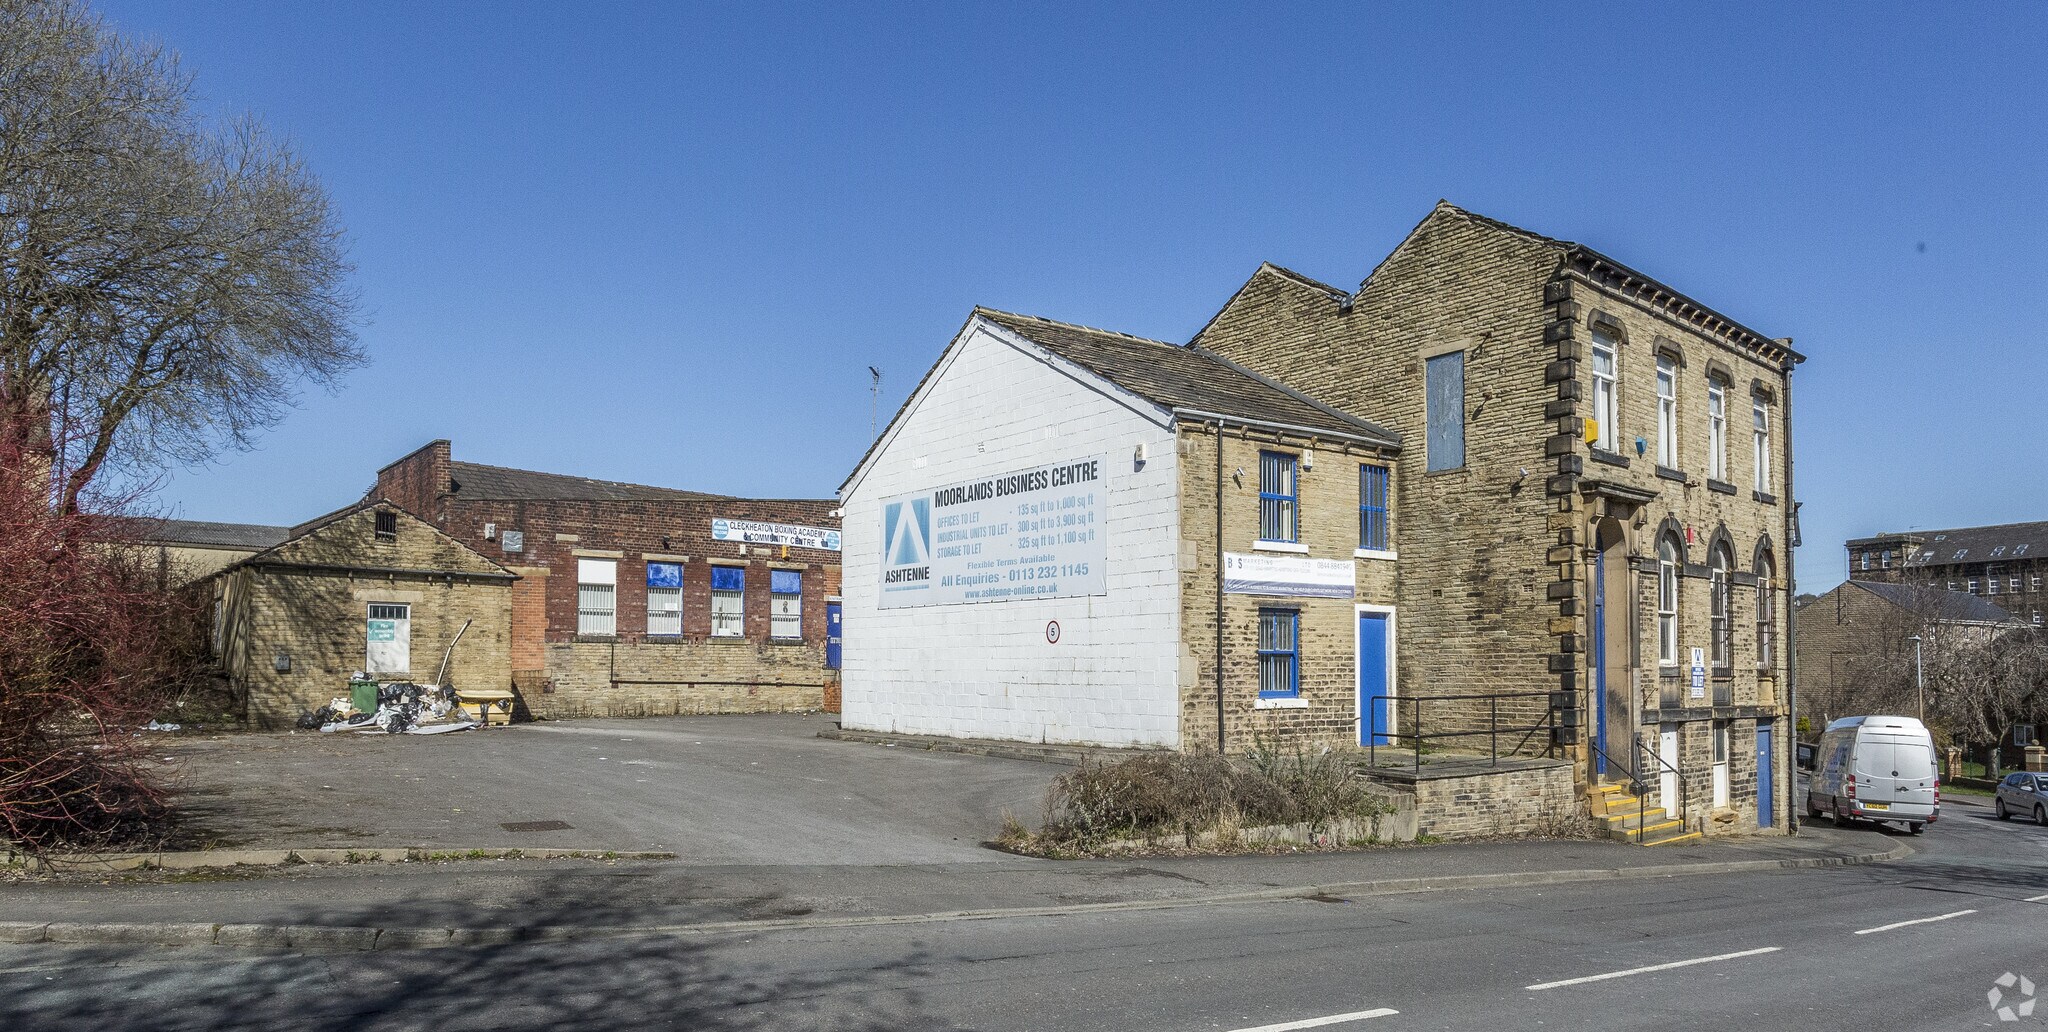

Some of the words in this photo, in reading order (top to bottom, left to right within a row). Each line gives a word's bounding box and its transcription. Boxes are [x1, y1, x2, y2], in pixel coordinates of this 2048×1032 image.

[935, 481, 992, 508] MOORLANDS
[997, 470, 1047, 497] BUSINESS
[1052, 461, 1097, 487] CENTRE
[938, 514, 959, 528] OFFICES
[961, 513, 968, 524] TO
[970, 512, 979, 522] LET
[1018, 504, 1029, 516] 135
[1031, 504, 1038, 516] sq
[1040, 501, 1045, 512] ft
[1047, 501, 1054, 511] to
[1057, 497, 1075, 511] 1,000
[1077, 497, 1085, 509] sq
[1088, 494, 1093, 505] ft
[730, 521, 772, 532] CLECKHEATON
[775, 526, 797, 535] BOXING
[798, 527, 826, 538] ACADEMY
[938, 528, 968, 543] INDUSTRIAL
[970, 525, 986, 538] UNITS
[989, 525, 996, 536] TO
[998, 523, 1008, 535] LET
[1018, 520, 1029, 532] 300
[1031, 521, 1038, 533] sq
[1040, 518, 1045, 529] ft
[1047, 518, 1054, 528] to
[1057, 514, 1075, 528] 3,900
[1078, 515, 1085, 526] sq
[1088, 511, 1094, 523] ft
[750, 531, 788, 544] COMMUNITY
[791, 536, 815, 546] CENTRE
[937, 545, 961, 558] STORAGE
[963, 544, 970, 556] TO
[972, 543, 982, 554] LET
[1018, 537, 1029, 549] 325
[1031, 538, 1039, 549] sq
[1041, 535, 1046, 546] ft
[1048, 535, 1054, 545] to
[1057, 531, 1076, 545] 1,100
[1078, 532, 1086, 543] sq
[1089, 529, 1094, 540] ft
[968, 560, 994, 570] Flexible
[997, 558, 1017, 567] Terms
[1020, 554, 1055, 564] Available
[1228, 558, 1232, 568] B
[1238, 558, 1242, 568] S
[885, 566, 930, 583] ASHTENNE
[941, 576, 952, 587] All
[956, 572, 999, 587] Enquiries
[1010, 568, 1034, 581] 0113
[1038, 566, 1057, 579] 232
[1061, 563, 1088, 576] 1145
[965, 582, 1057, 598] www.ashtenne-online.co.uk
[1051, 628, 1055, 636] 5
